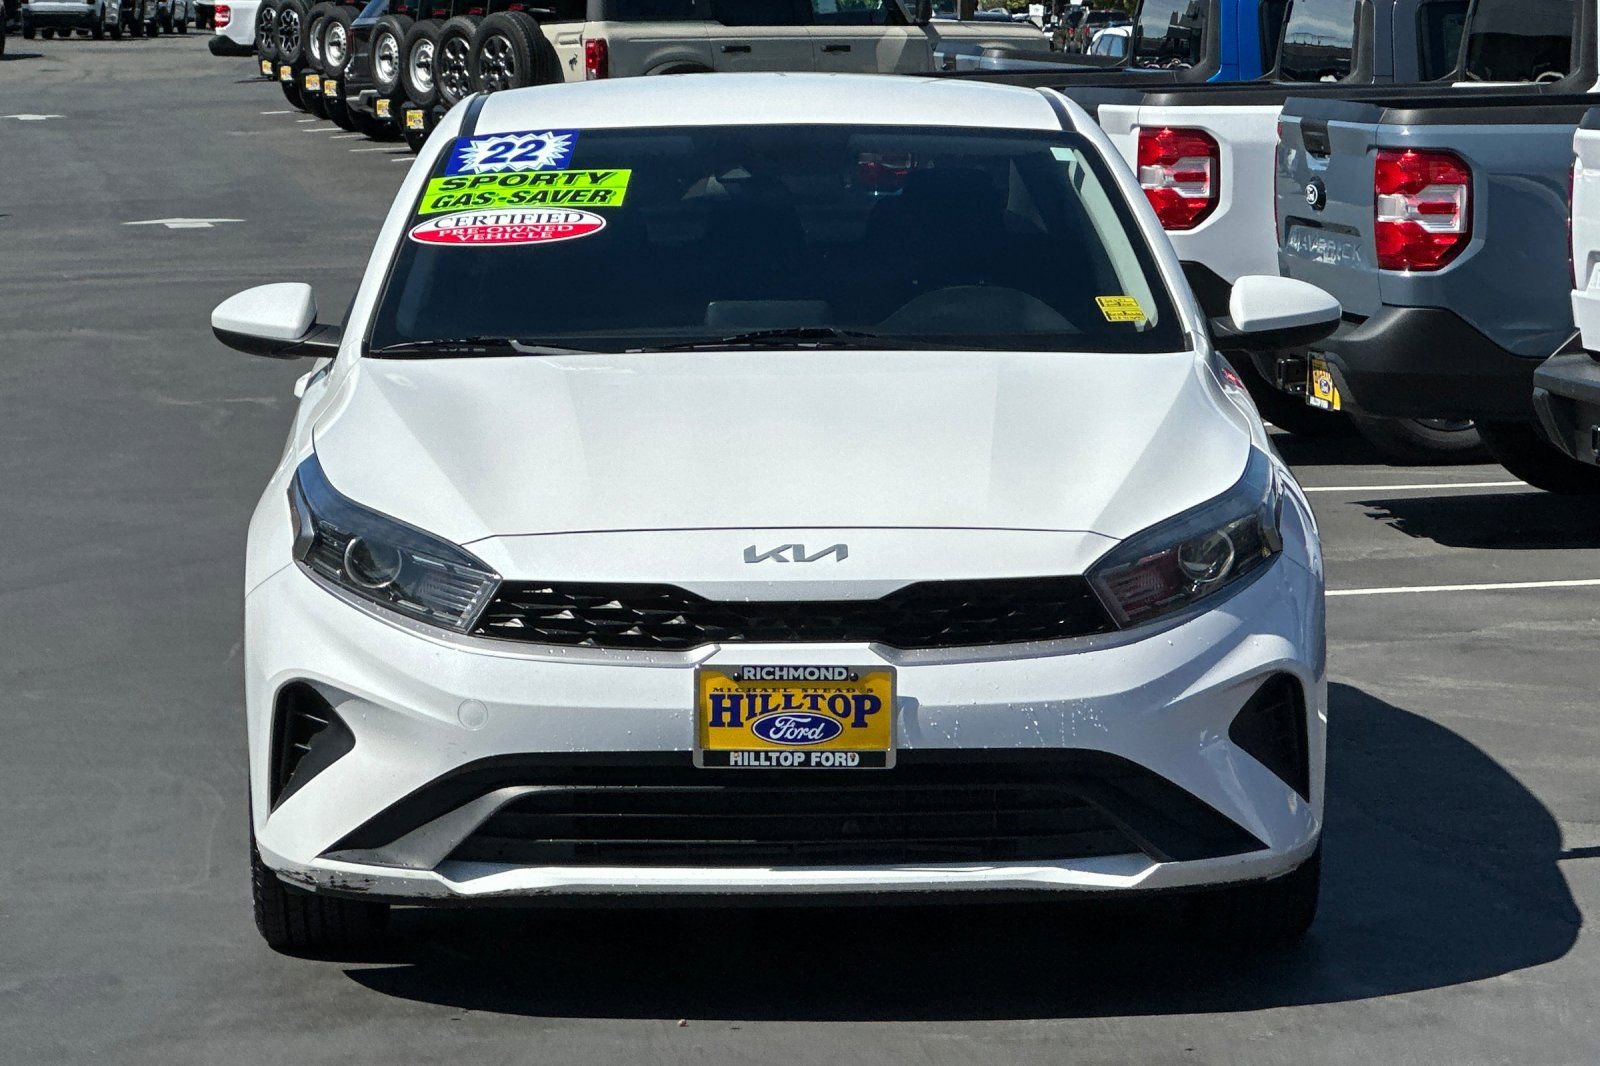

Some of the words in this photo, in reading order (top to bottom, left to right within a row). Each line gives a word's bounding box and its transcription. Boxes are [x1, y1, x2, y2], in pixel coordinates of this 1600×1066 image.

[478, 139, 547, 164] 22
[438, 171, 617, 191] SPORTY
[431, 188, 616, 209] GAS-SAVER
[433, 212, 584, 229] CERTIFIED
[438, 224, 575, 237] PRE-OWNED
[458, 231, 553, 241] VEHICLE
[743, 667, 848, 681] RICHMOND
[708, 693, 882, 728] HILLTOP
[768, 715, 825, 740] Ford
[729, 751, 806, 767] HILLTOP
[810, 751, 860, 767] FORD
